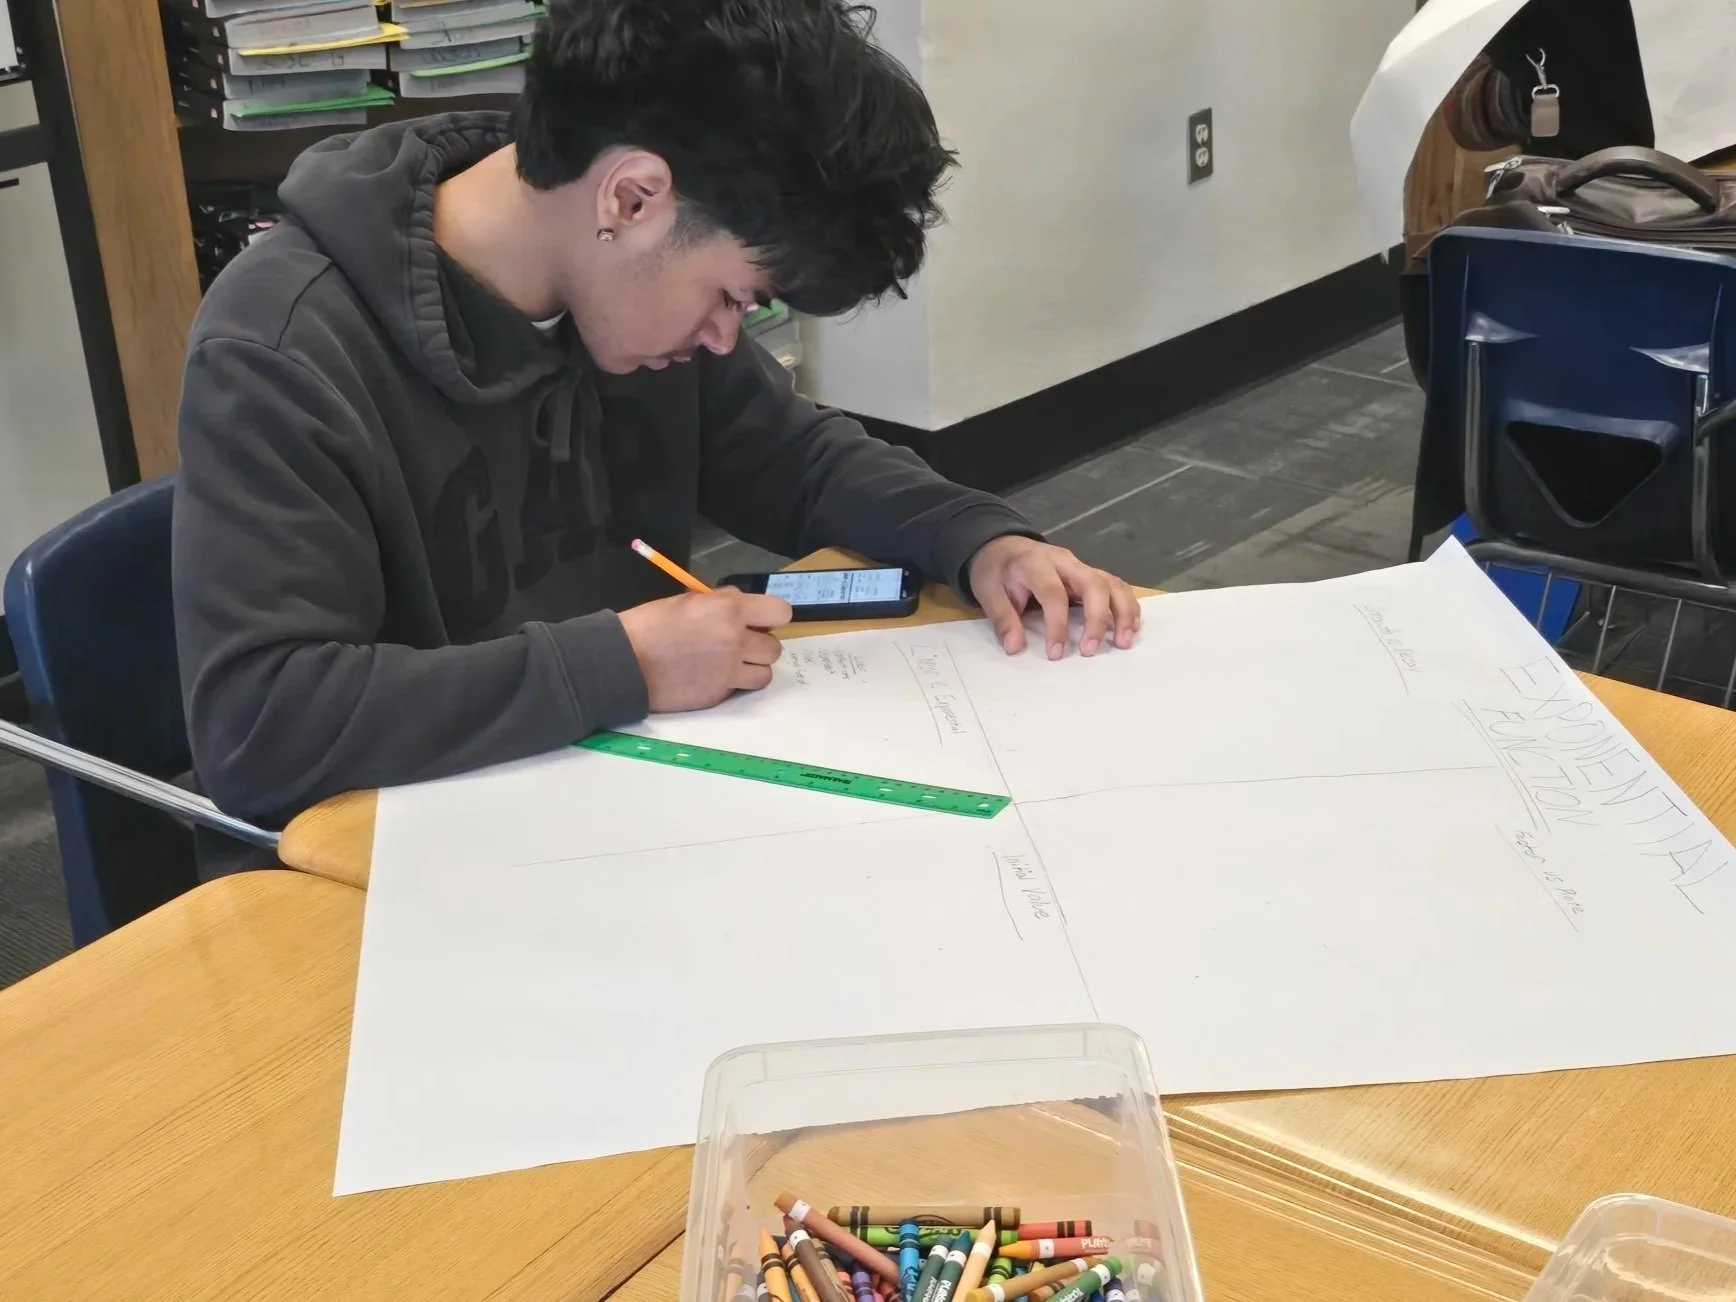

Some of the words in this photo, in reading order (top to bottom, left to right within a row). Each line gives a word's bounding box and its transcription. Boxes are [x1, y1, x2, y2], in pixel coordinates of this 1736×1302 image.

[1479, 707, 1602, 826] FUNCTION
[1499, 655, 1729, 915] EXPONENTIAL
[1000, 854, 1037, 881] Initial
[1021, 887, 1052, 920] Value
